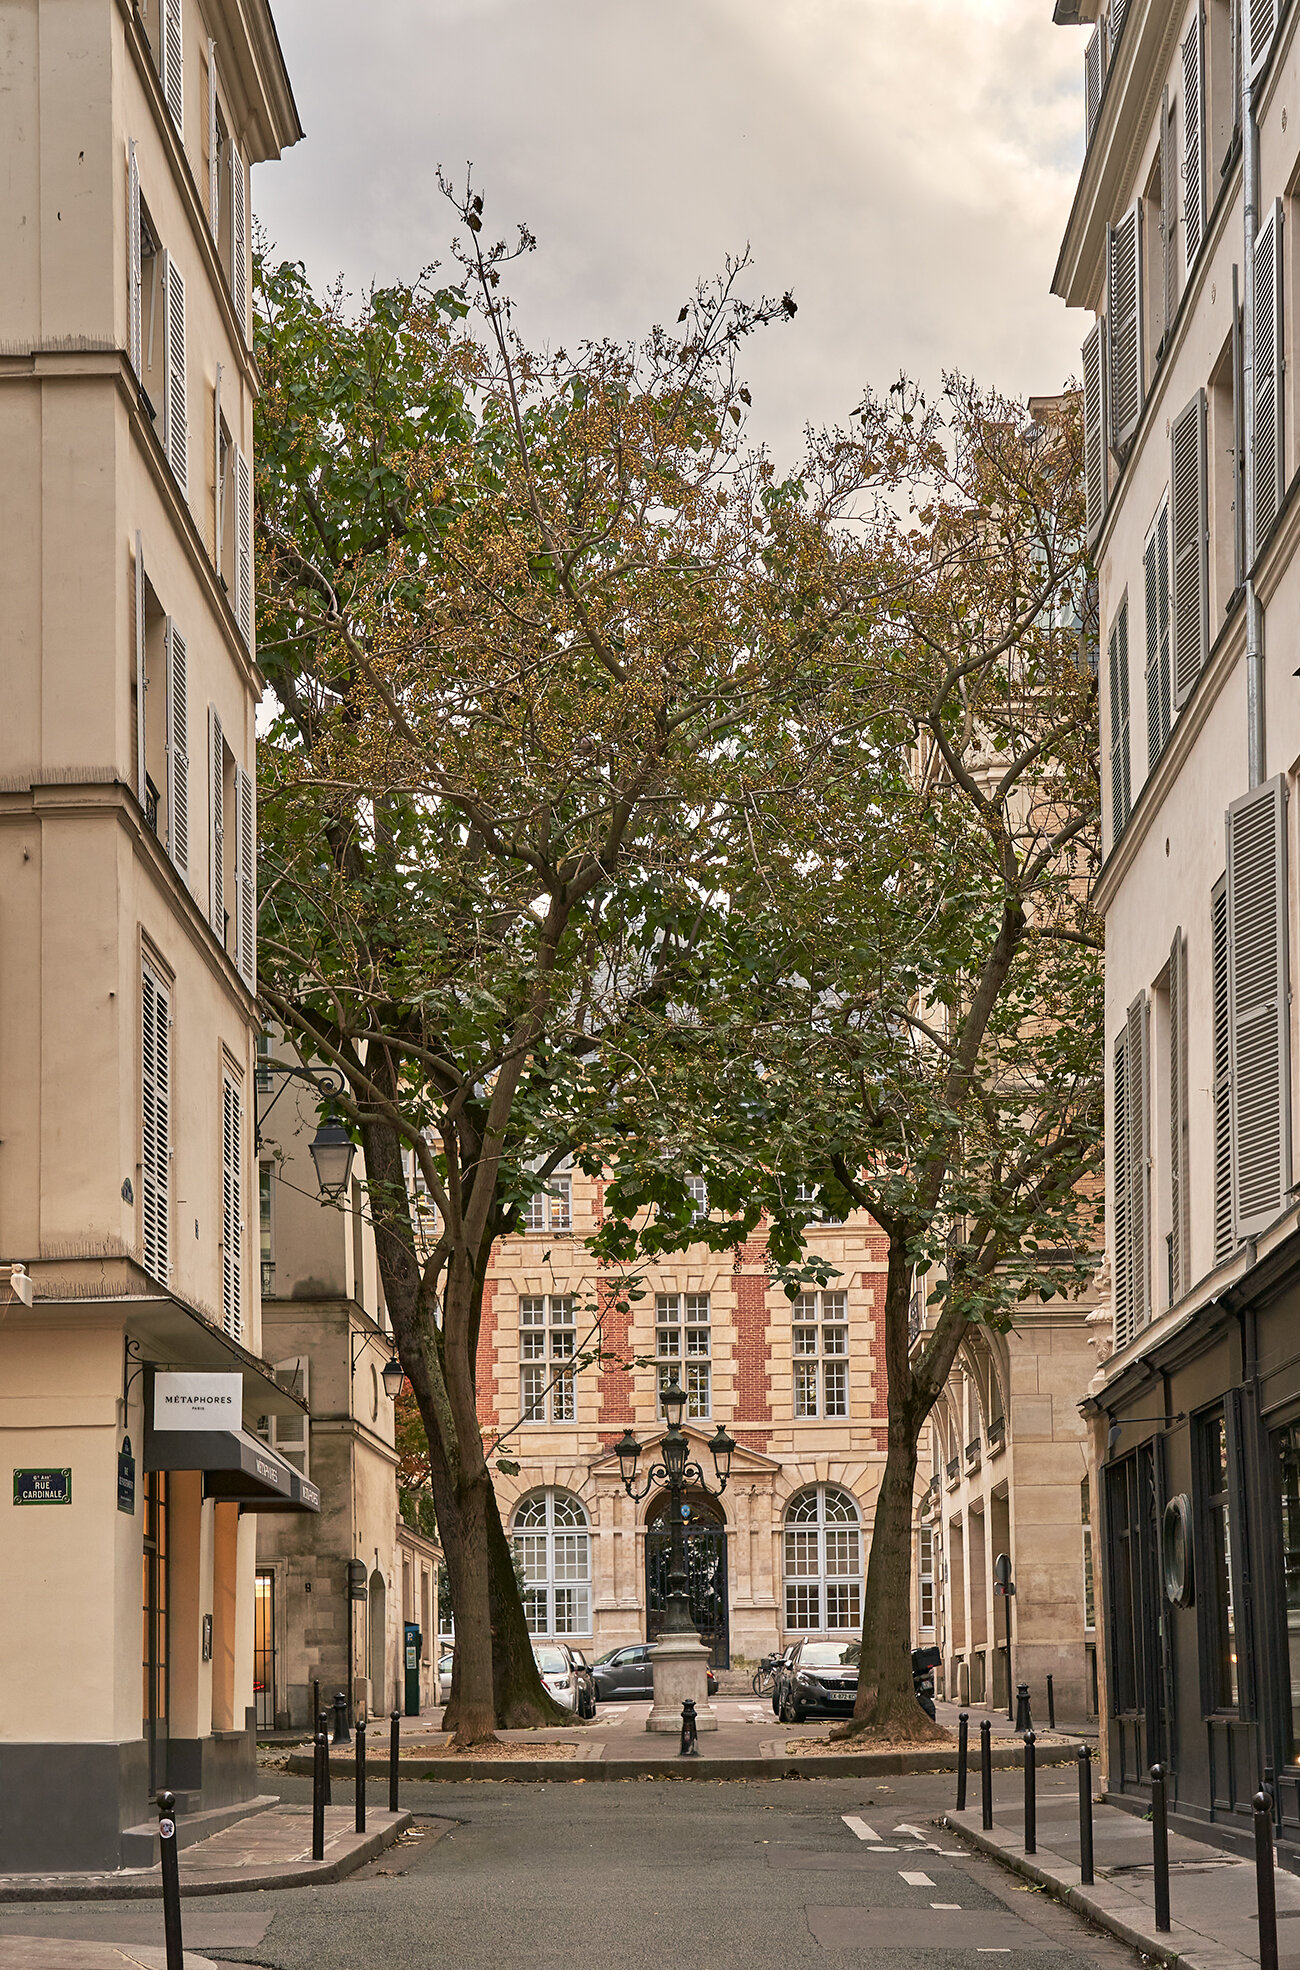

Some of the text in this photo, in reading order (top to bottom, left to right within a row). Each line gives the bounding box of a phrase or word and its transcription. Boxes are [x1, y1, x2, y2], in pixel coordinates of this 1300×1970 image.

[165, 1395, 232, 1404] MÉTAPHORES
[35, 1482, 50, 1490] RUE
[22, 1490, 63, 1499] CARDINALE
